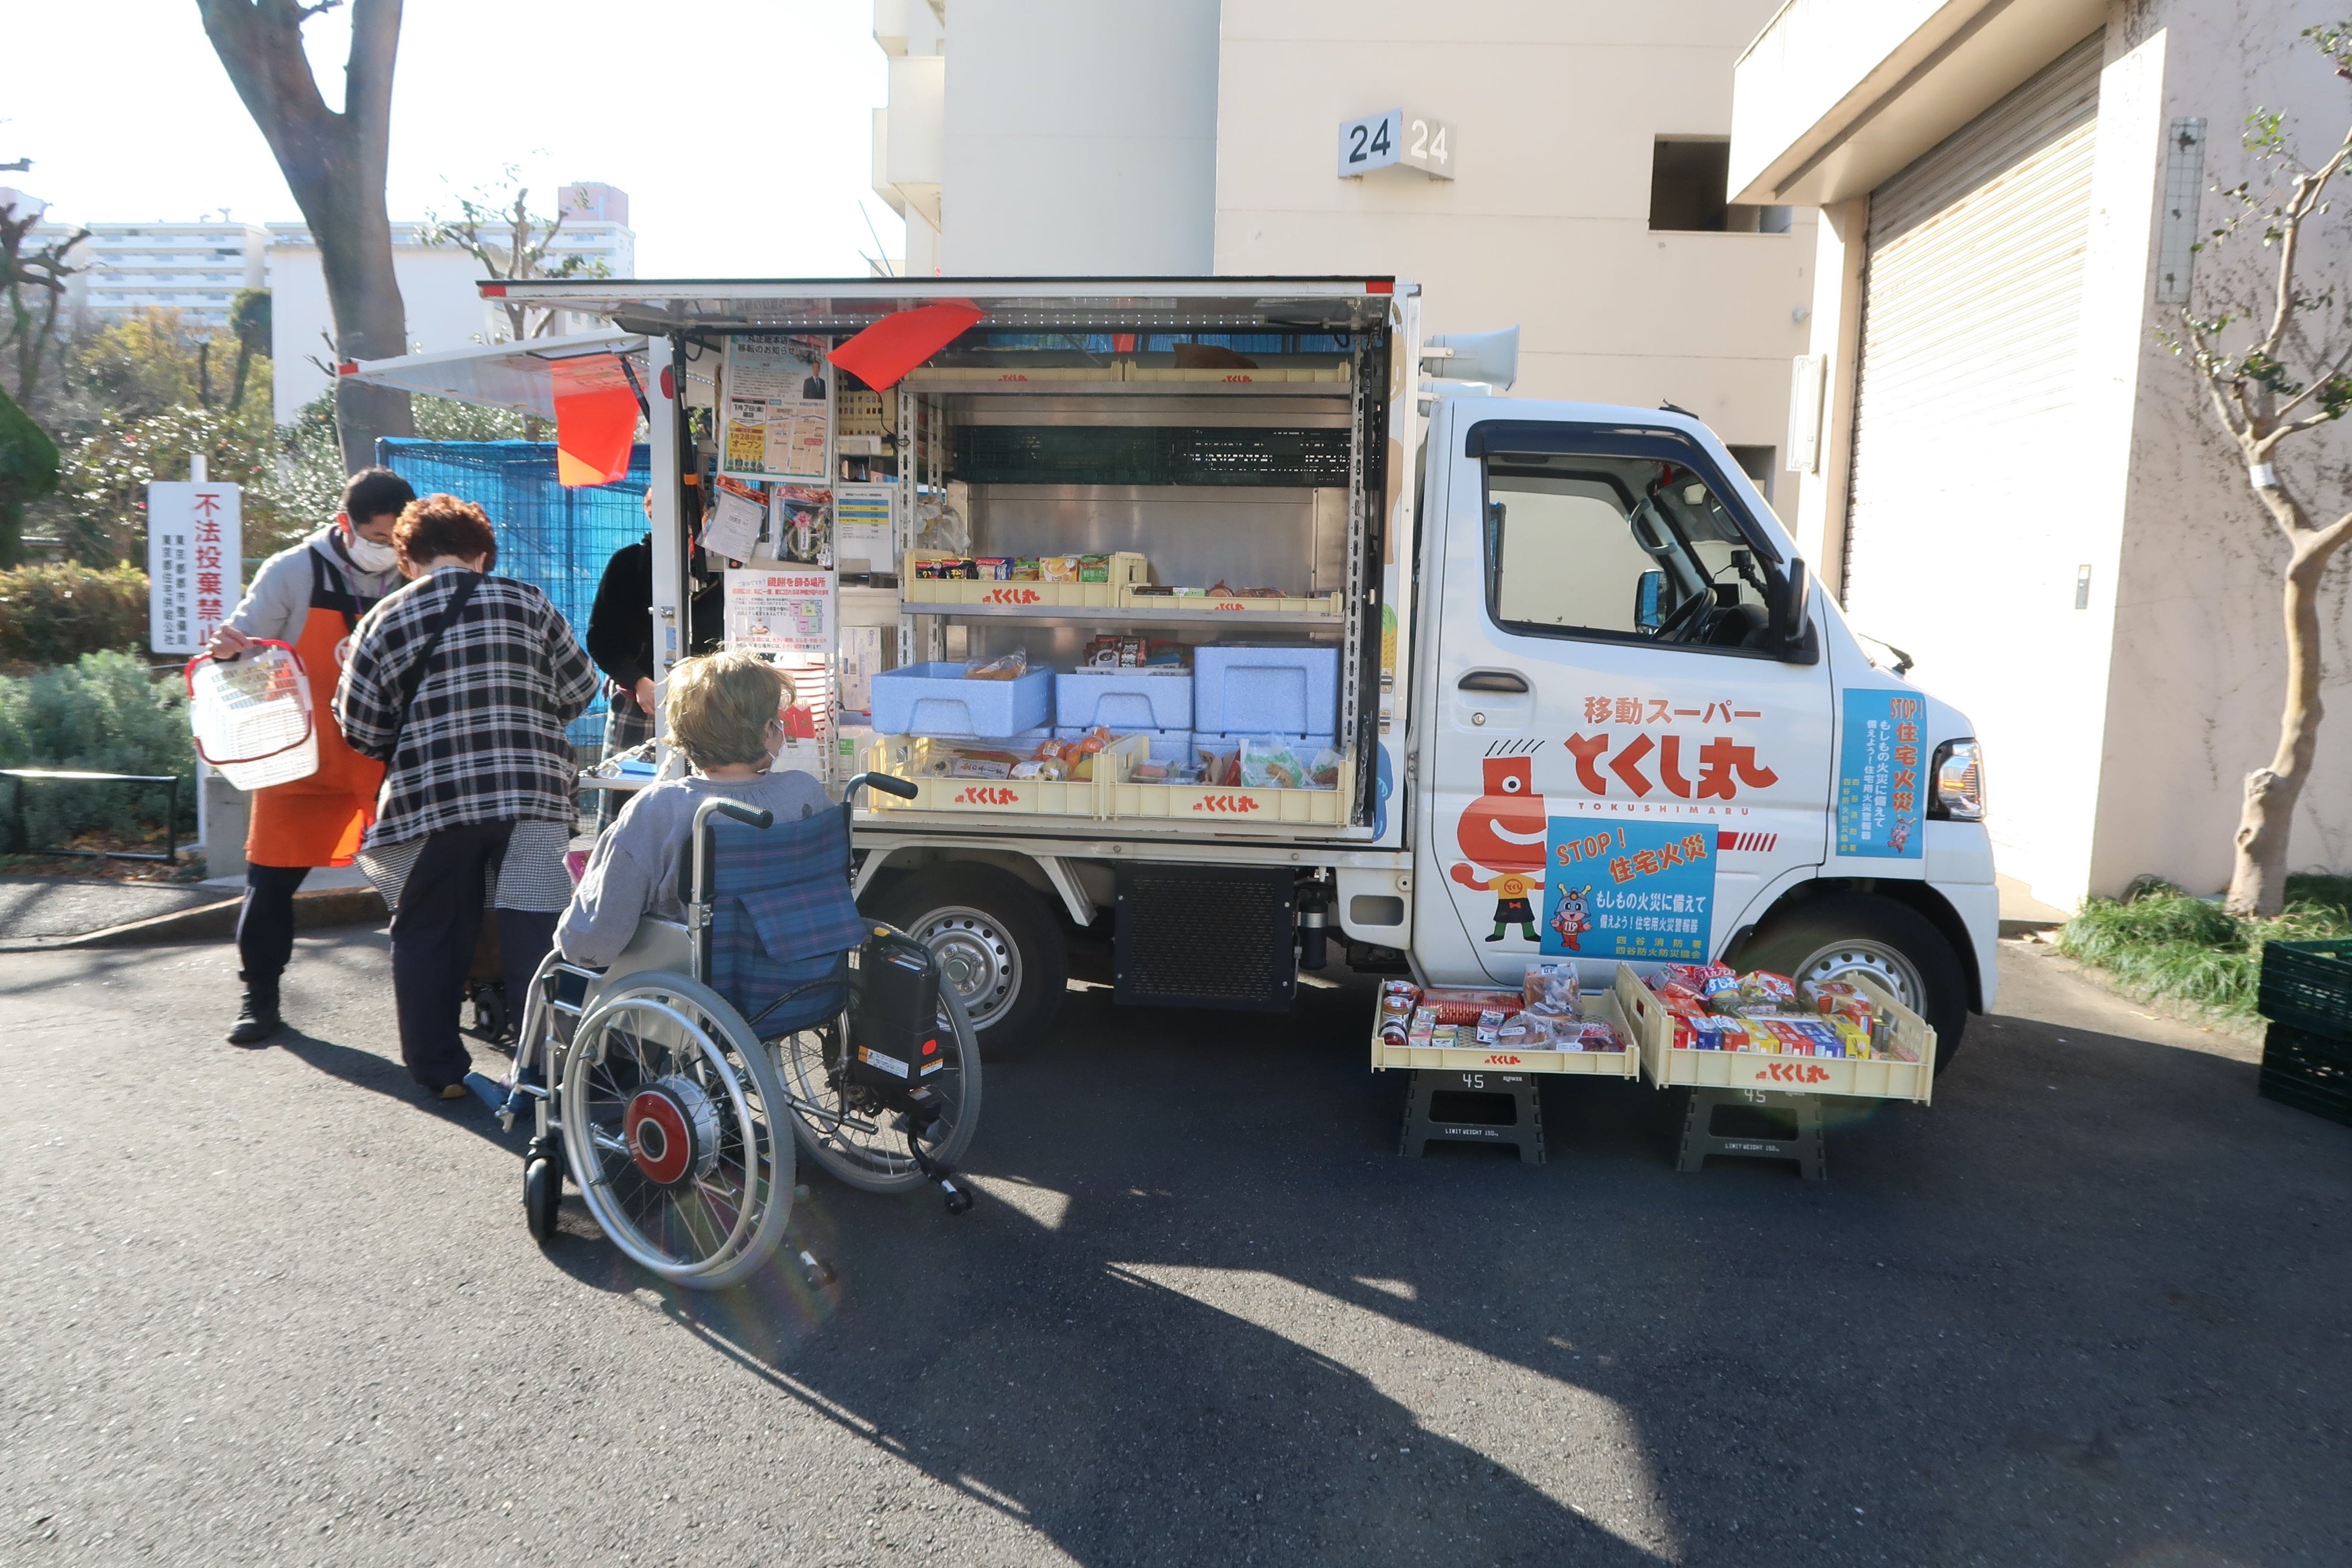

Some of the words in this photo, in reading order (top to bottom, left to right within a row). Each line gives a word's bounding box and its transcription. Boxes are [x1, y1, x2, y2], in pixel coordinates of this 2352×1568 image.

[1349, 118, 1391, 163] 24
[1411, 119, 1447, 165] 24
[738, 343, 795, 355] 移転のお知らせ
[732, 440, 762, 449] オープン
[992, 589, 1041, 604] とくし丸
[1584, 695, 1762, 724] 移動スーパー
[1563, 732, 1779, 800] とくし丸
[1875, 720, 1891, 828] もしもの火災に備えて
[1892, 721, 1919, 813] 住宅火災
[965, 786, 1019, 805] とくし丸
[1203, 795, 1259, 813] とくし丸
[1579, 802, 1751, 816] TOKUSHIMARU
[1609, 833, 1708, 884] 住宅火災
[1596, 890, 1707, 913] もしもの火災に備えて
[1564, 921, 1578, 932] 119
[1600, 914, 1699, 934] 備えよう!住宅用火災警報器
[1616, 936, 1702, 948] 四谷消防署
[1490, 1055, 1521, 1065] とくし丸
[1463, 1073, 1484, 1089] 45
[1768, 1063, 1830, 1084] とくし丸
[1744, 1089, 1766, 1103] 45
